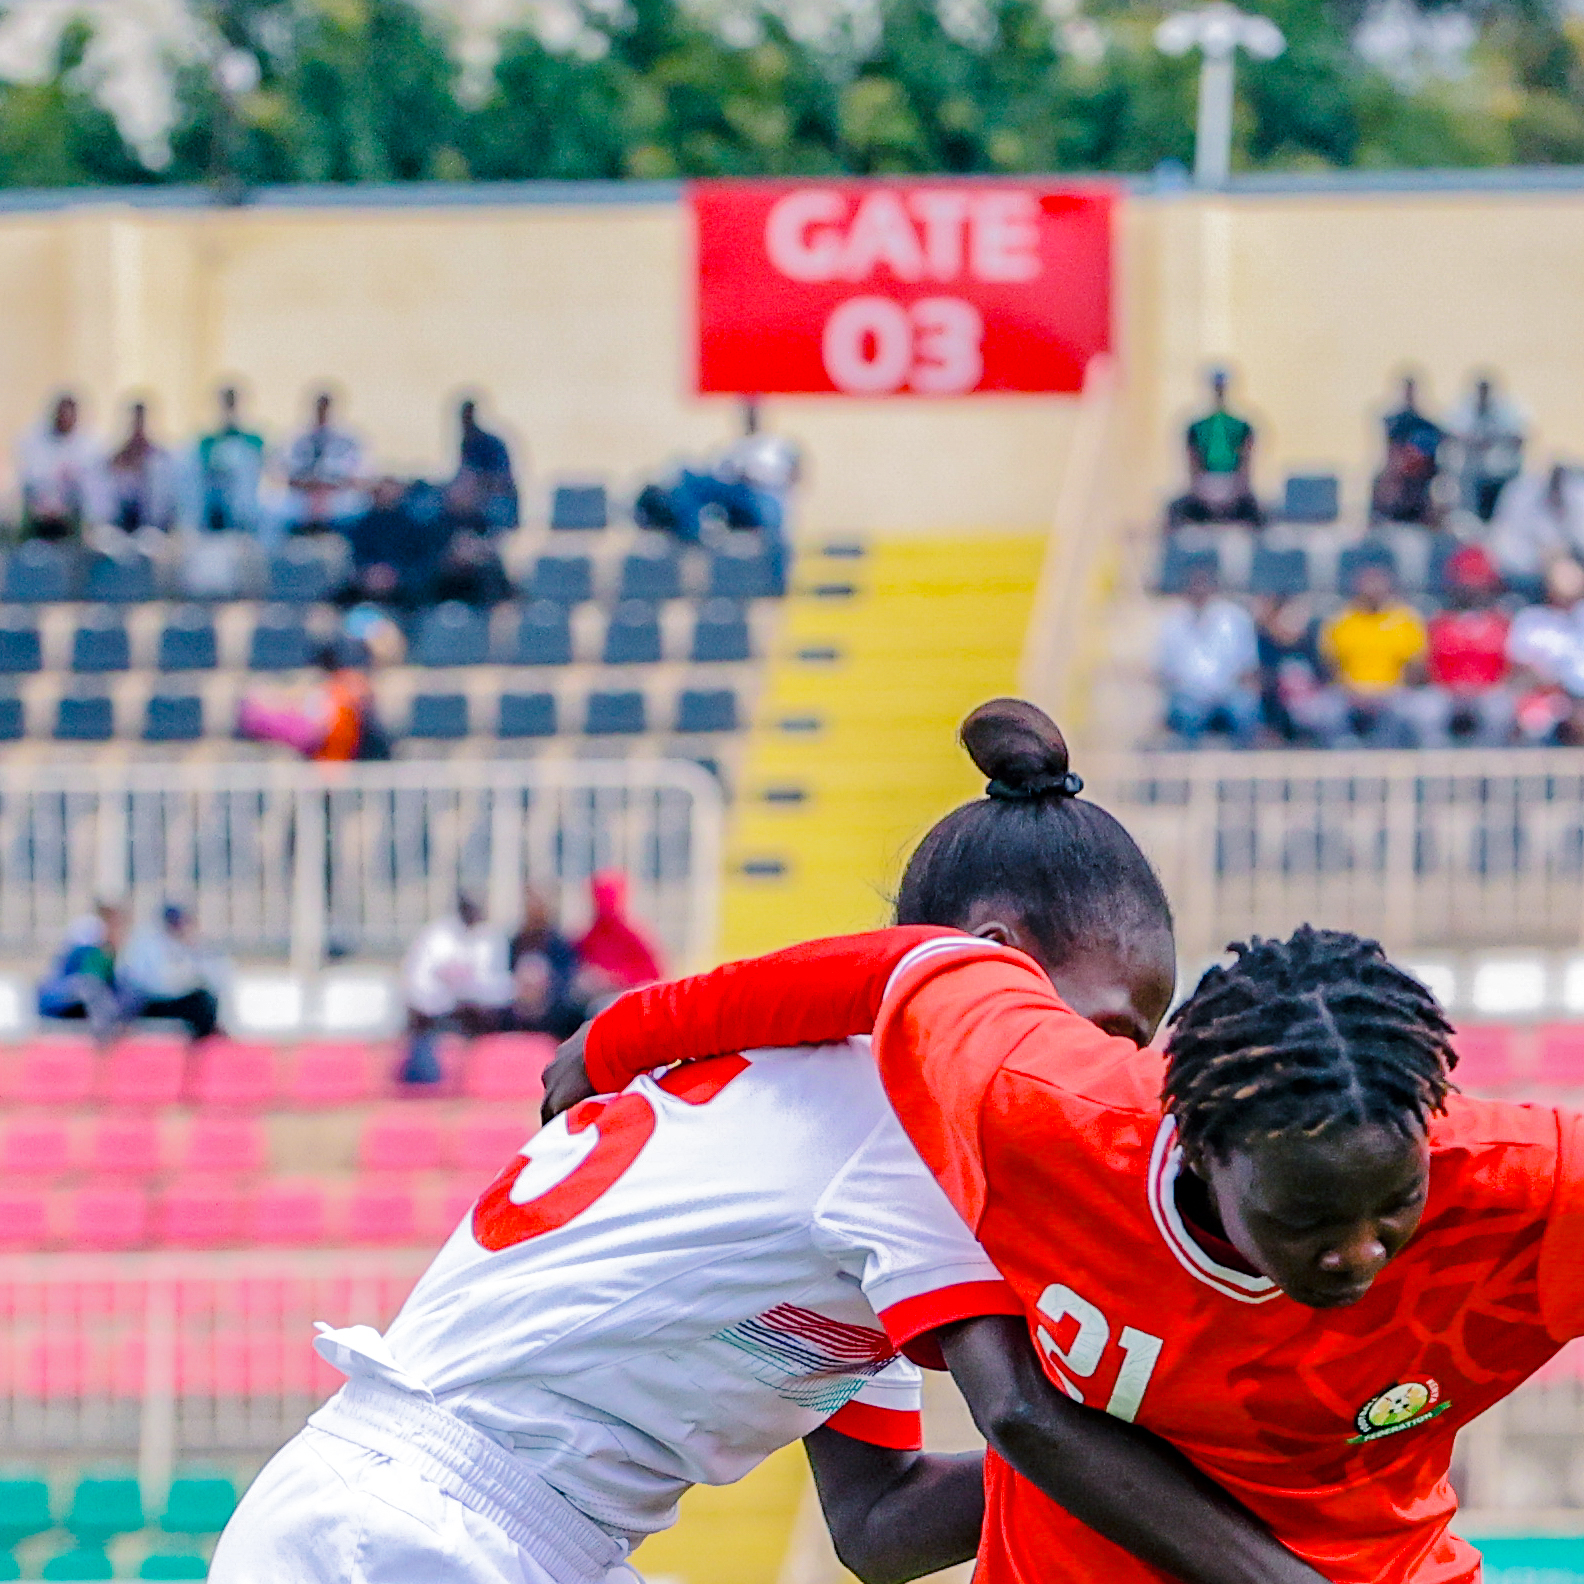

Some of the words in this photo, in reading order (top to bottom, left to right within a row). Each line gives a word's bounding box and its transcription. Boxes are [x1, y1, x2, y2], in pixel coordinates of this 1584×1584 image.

[766, 189, 1041, 282] GATE
[822, 296, 984, 394] 03
[1036, 1283, 1163, 1423] 21
